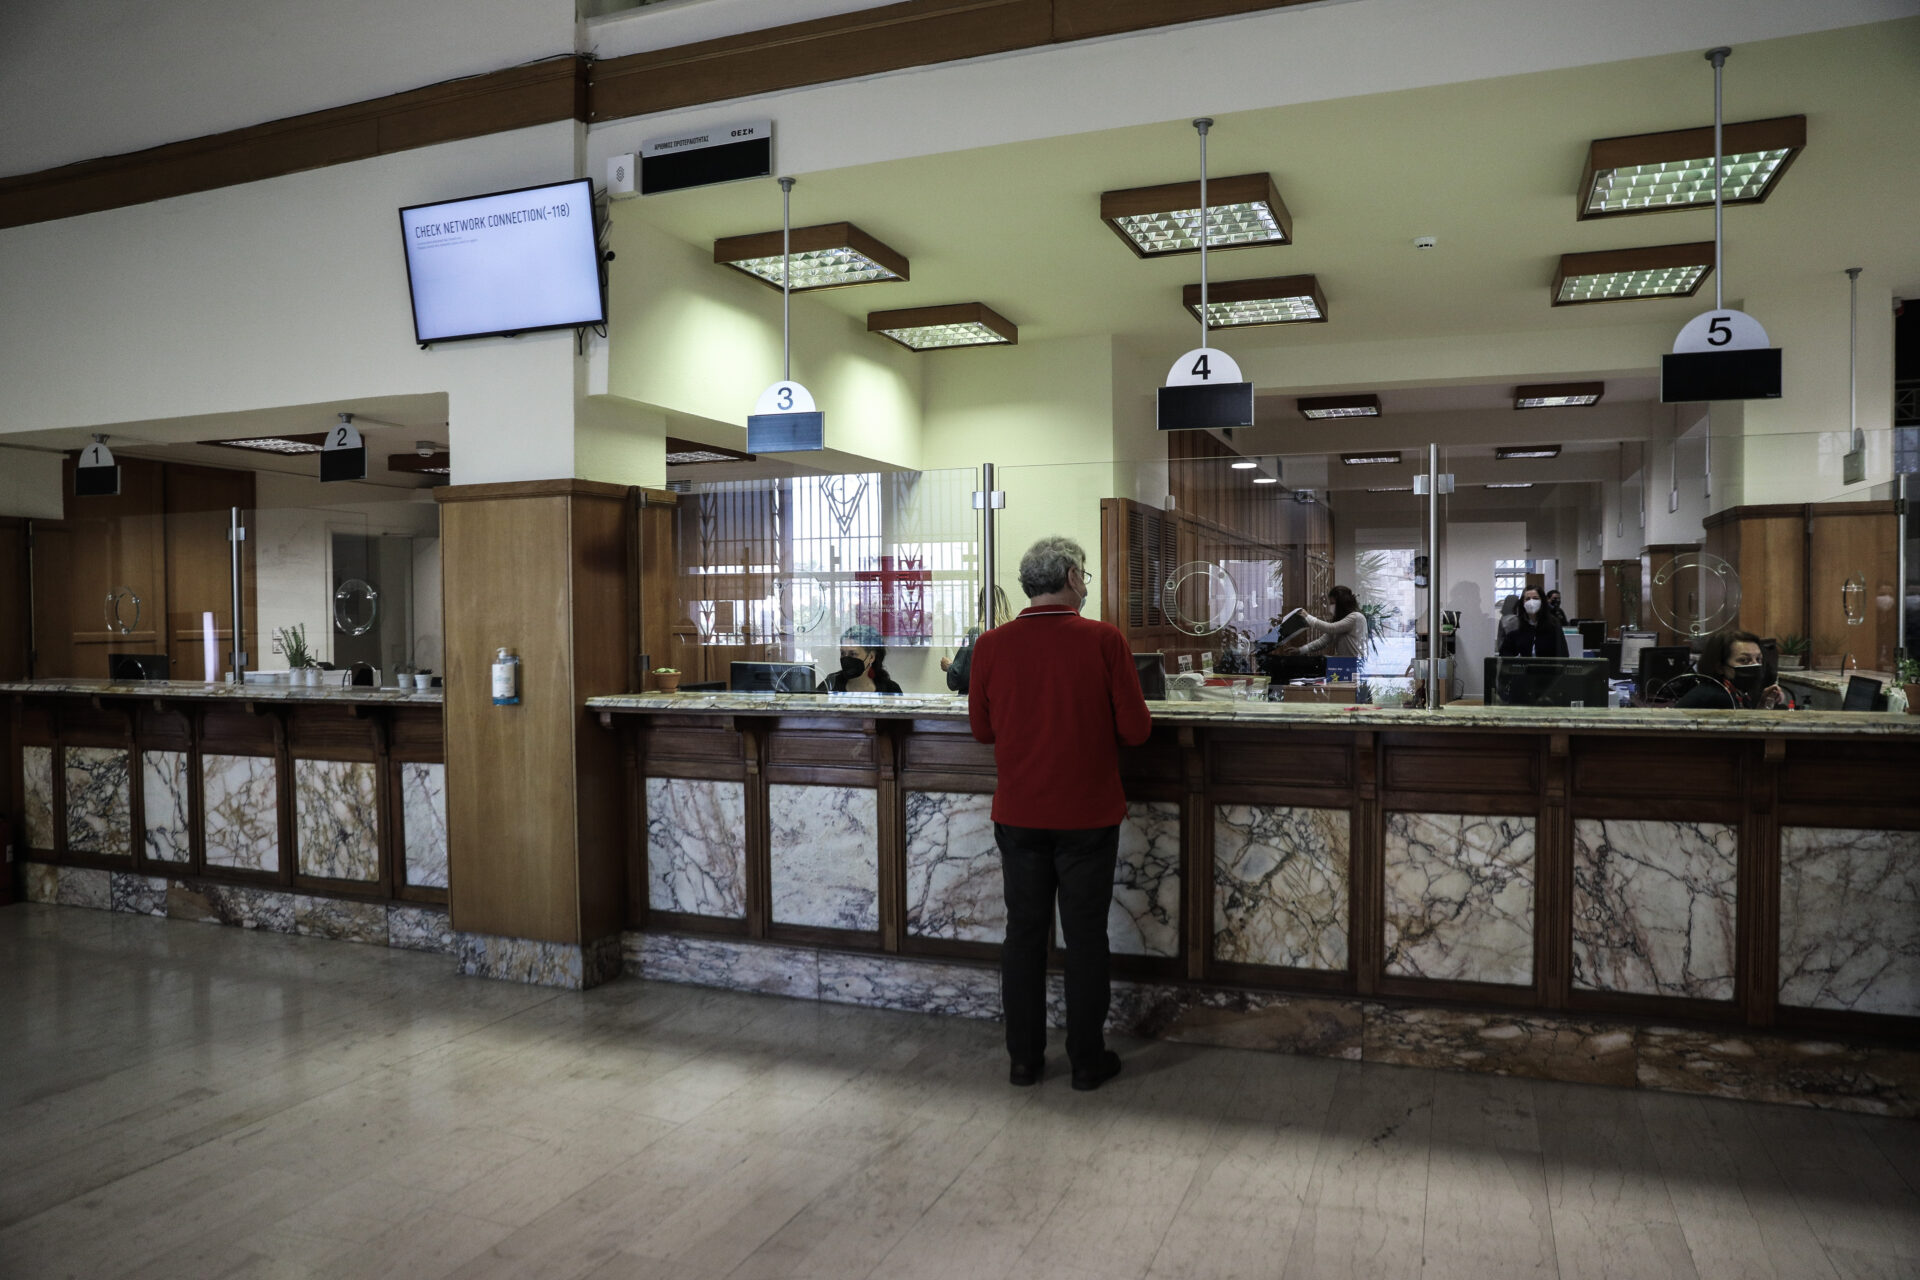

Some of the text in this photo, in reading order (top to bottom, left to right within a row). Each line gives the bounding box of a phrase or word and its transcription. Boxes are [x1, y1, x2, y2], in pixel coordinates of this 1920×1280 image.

[731, 127, 754, 138] ΘΕΣΗ
[415, 203, 570, 239] CHECK NETWORK CONNECTION(-118)
[1707, 316, 1733, 347] 5
[1191, 354, 1212, 381] 4
[777, 386, 794, 411] 3
[336, 427, 347, 447] 2
[92, 446, 100, 465] 1
